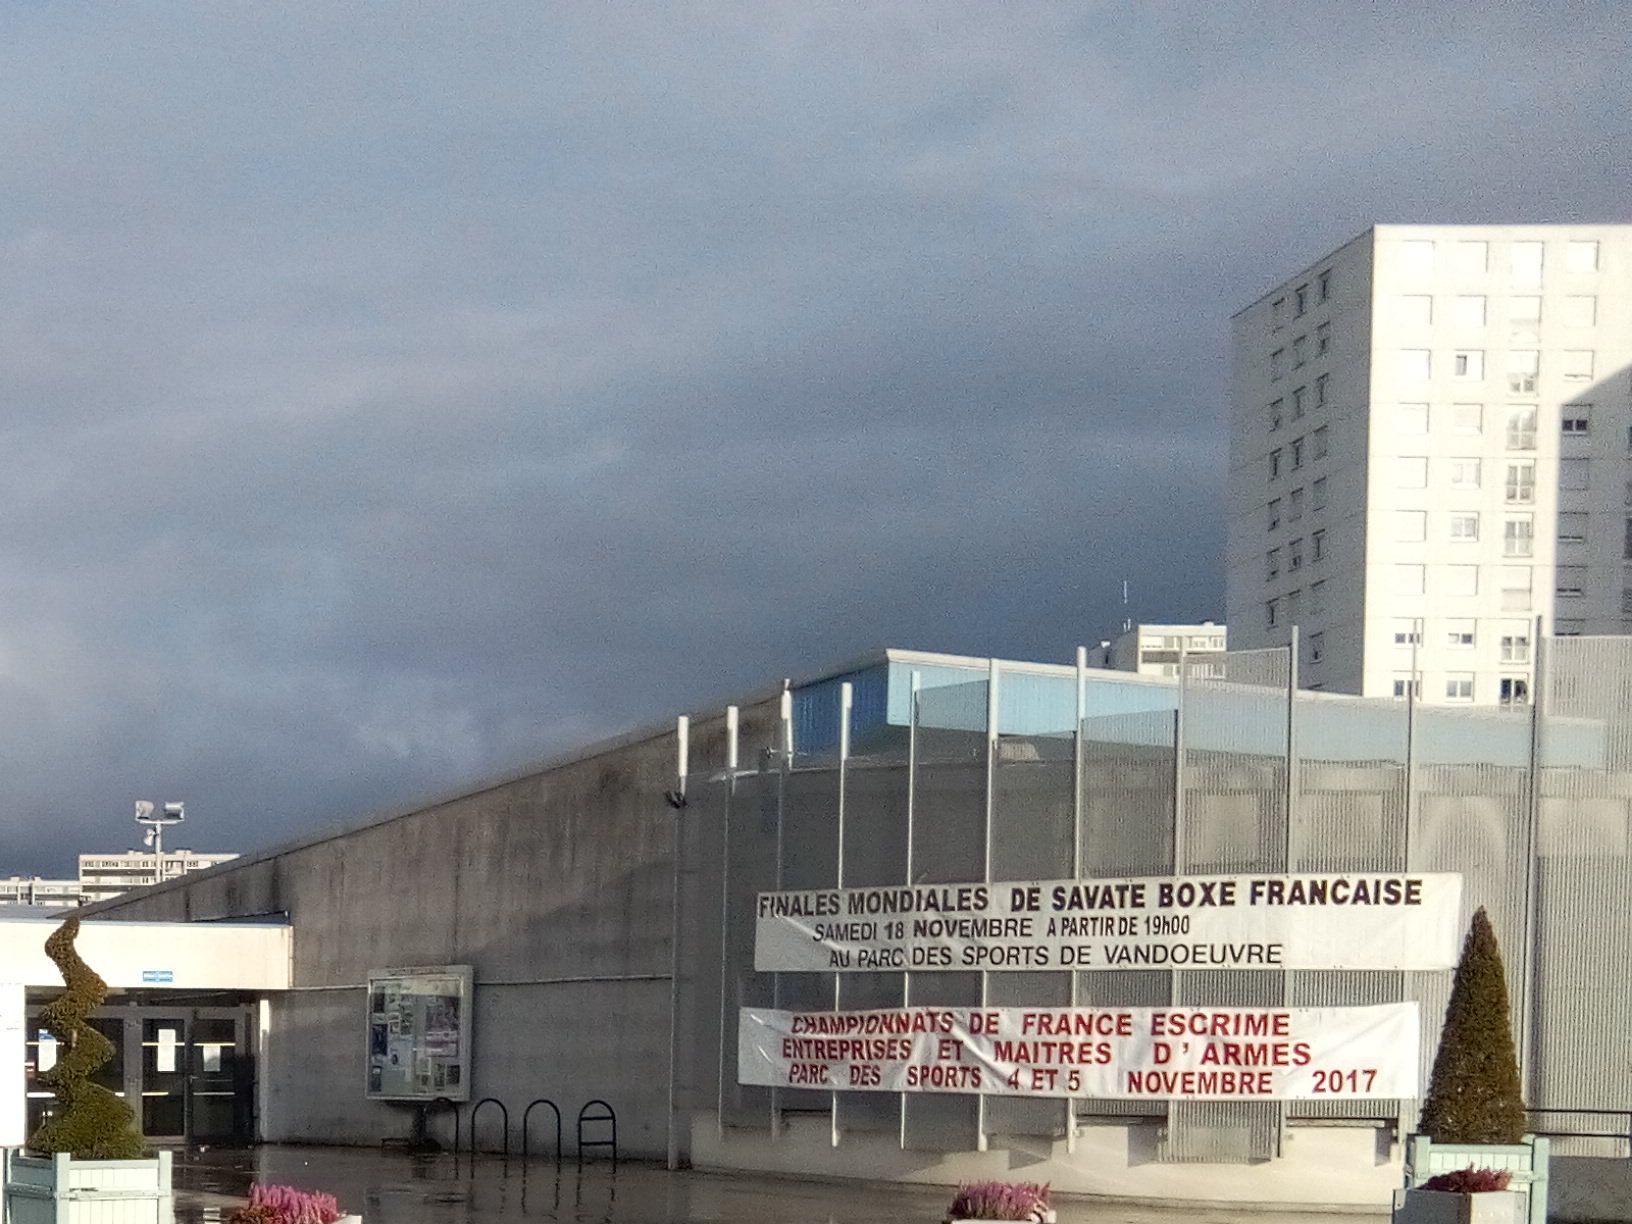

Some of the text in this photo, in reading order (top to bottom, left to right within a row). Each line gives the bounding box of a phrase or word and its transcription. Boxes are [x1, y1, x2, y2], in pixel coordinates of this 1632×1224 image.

[758, 879, 1422, 918] FINALES MONDIALES DE SAVATE BOXE FRANCAISE
[812, 915, 1190, 942] SAMEDI 18 NOVEMBRE A PARTIR DE 19h00
[829, 943, 1283, 968] AU PARC DES SPORTS DE VANDOEUVRE
[791, 1012, 1290, 1036] CHAMPIONNATS DE FRANCE ESCRIME
[782, 1038, 912, 1061] ENTREPRISES
[937, 1039, 964, 1061] ET
[994, 1040, 1111, 1064] MAITRES
[789, 1064, 1378, 1095] PARC DES SPORTS 4 ET 5 NOVEMBRE 2017
